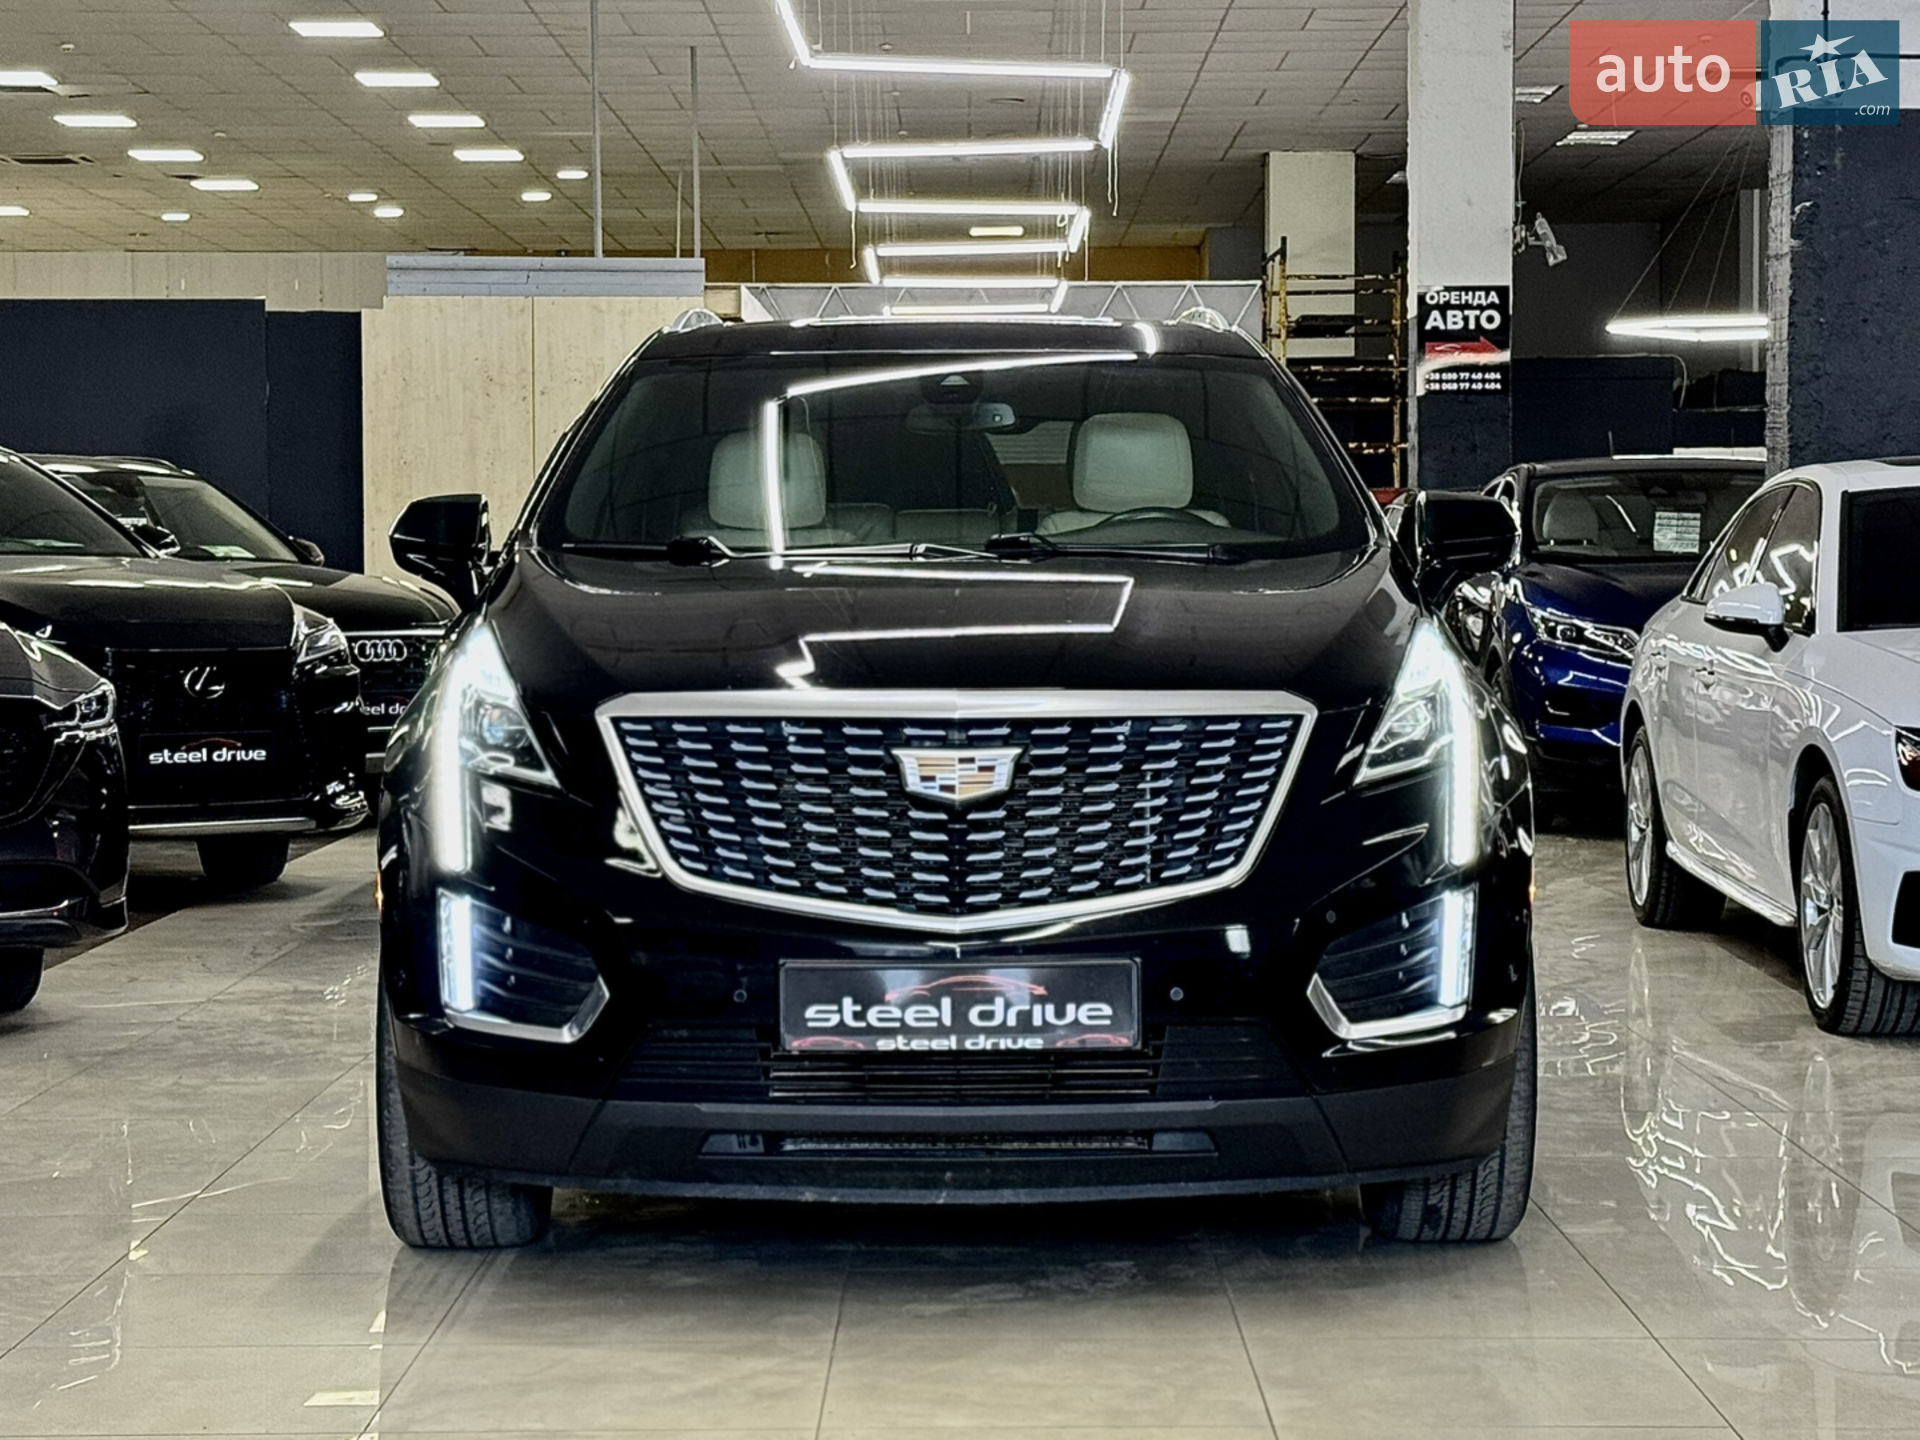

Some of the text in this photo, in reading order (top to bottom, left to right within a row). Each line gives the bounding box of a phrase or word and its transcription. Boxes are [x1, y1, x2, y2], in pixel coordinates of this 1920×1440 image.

[1425, 291, 1500, 306] ОРЕНДА
[1424, 309, 1501, 330] АВТО
[1459, 372, 1470, 381] 77
[1471, 372, 1483, 381] 40
[1484, 372, 1502, 381] 404
[1459, 382, 1470, 391] 77
[1471, 382, 1483, 391] 40
[1484, 382, 1502, 391] 404
[149, 747, 266, 764] steel drive
[804, 996, 1113, 1028] steel drive
[876, 1034, 1044, 1050] steel drive
